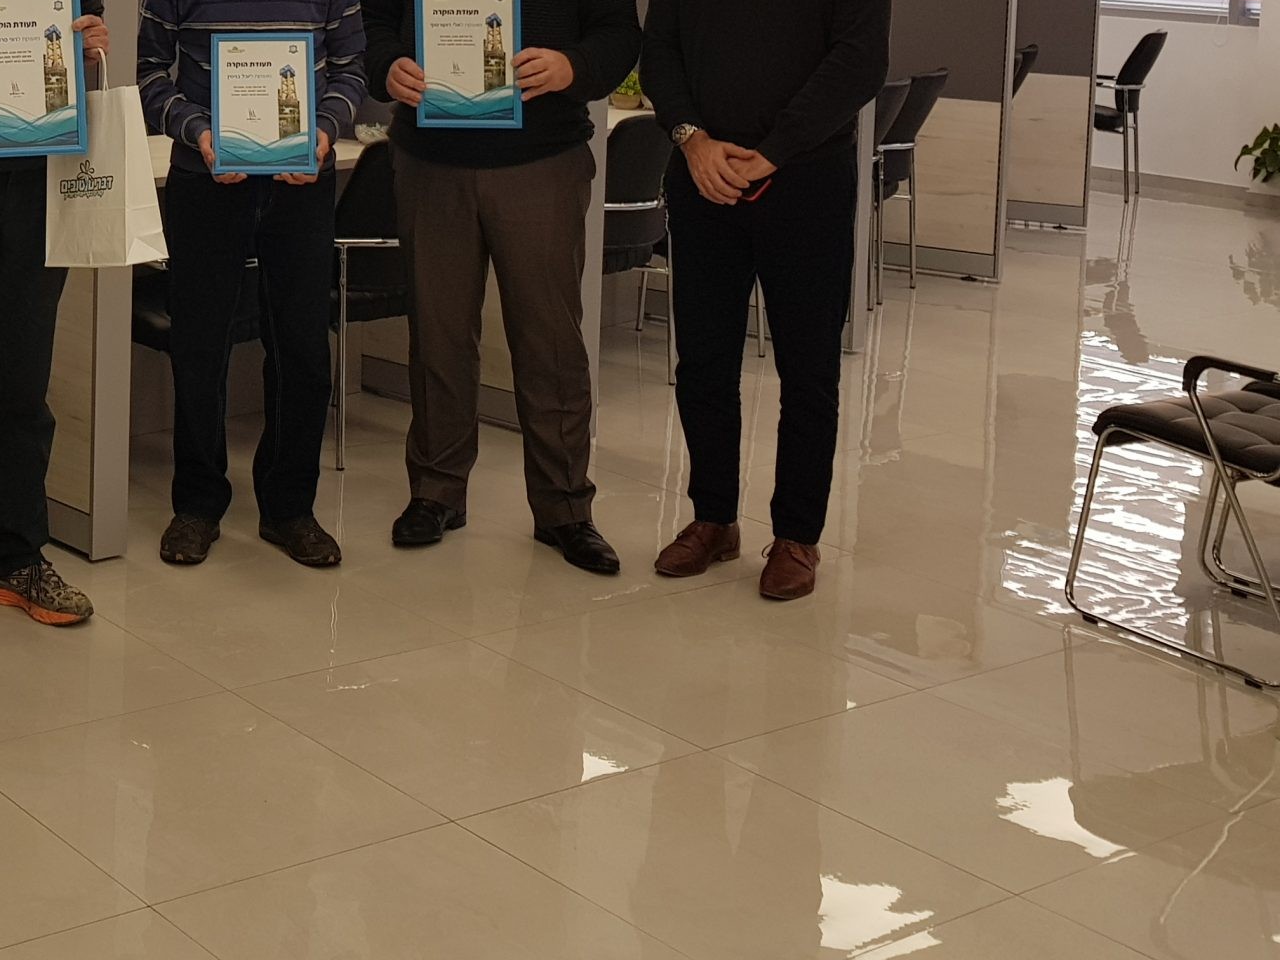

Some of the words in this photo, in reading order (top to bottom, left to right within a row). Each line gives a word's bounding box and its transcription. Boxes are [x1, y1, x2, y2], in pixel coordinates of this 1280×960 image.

[432, 9, 455, 17] הוקרה
[13, 21, 37, 29] תעודת
[226, 61, 248, 69] הוקרה
